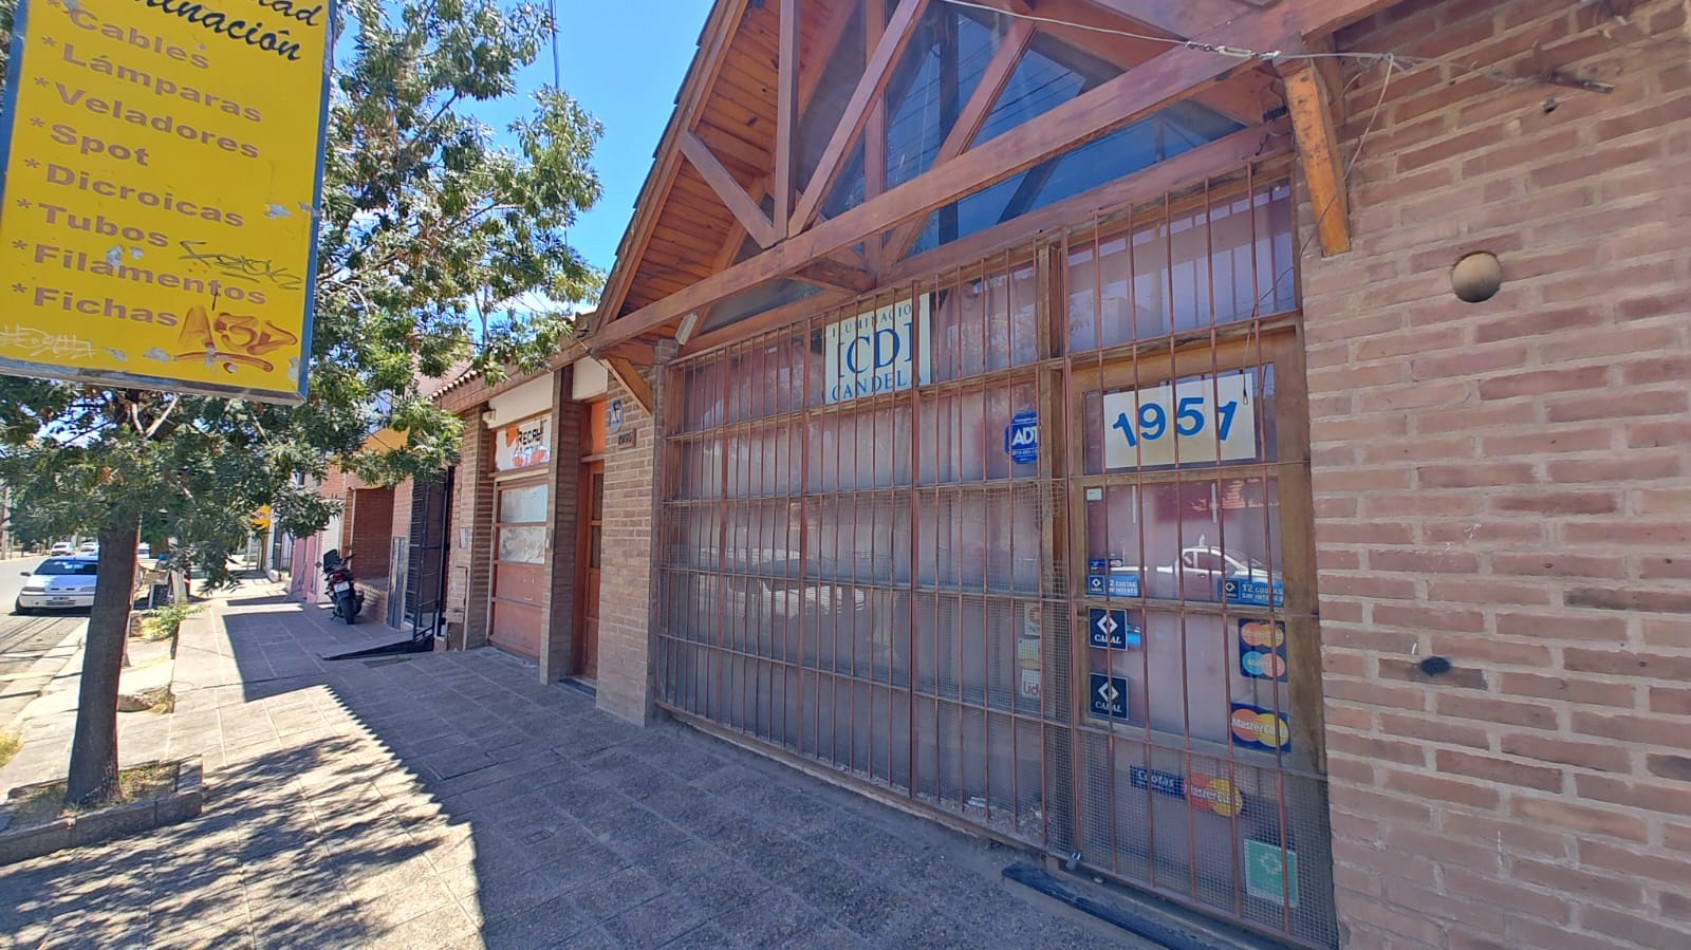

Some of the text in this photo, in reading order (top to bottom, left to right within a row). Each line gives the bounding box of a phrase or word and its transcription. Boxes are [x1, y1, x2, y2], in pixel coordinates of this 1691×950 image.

[69, 9, 210, 70] Cables
[62, 44, 262, 123] Lámparas
[50, 124, 150, 167] Spot
[55, 82, 260, 159] Veladores
[38, 202, 169, 248] Tubos
[46, 163, 245, 227] Dicroicas
[33, 244, 267, 306] Filamentos
[33, 286, 179, 328] Fichas
[1112, 396, 1237, 447] 1951
